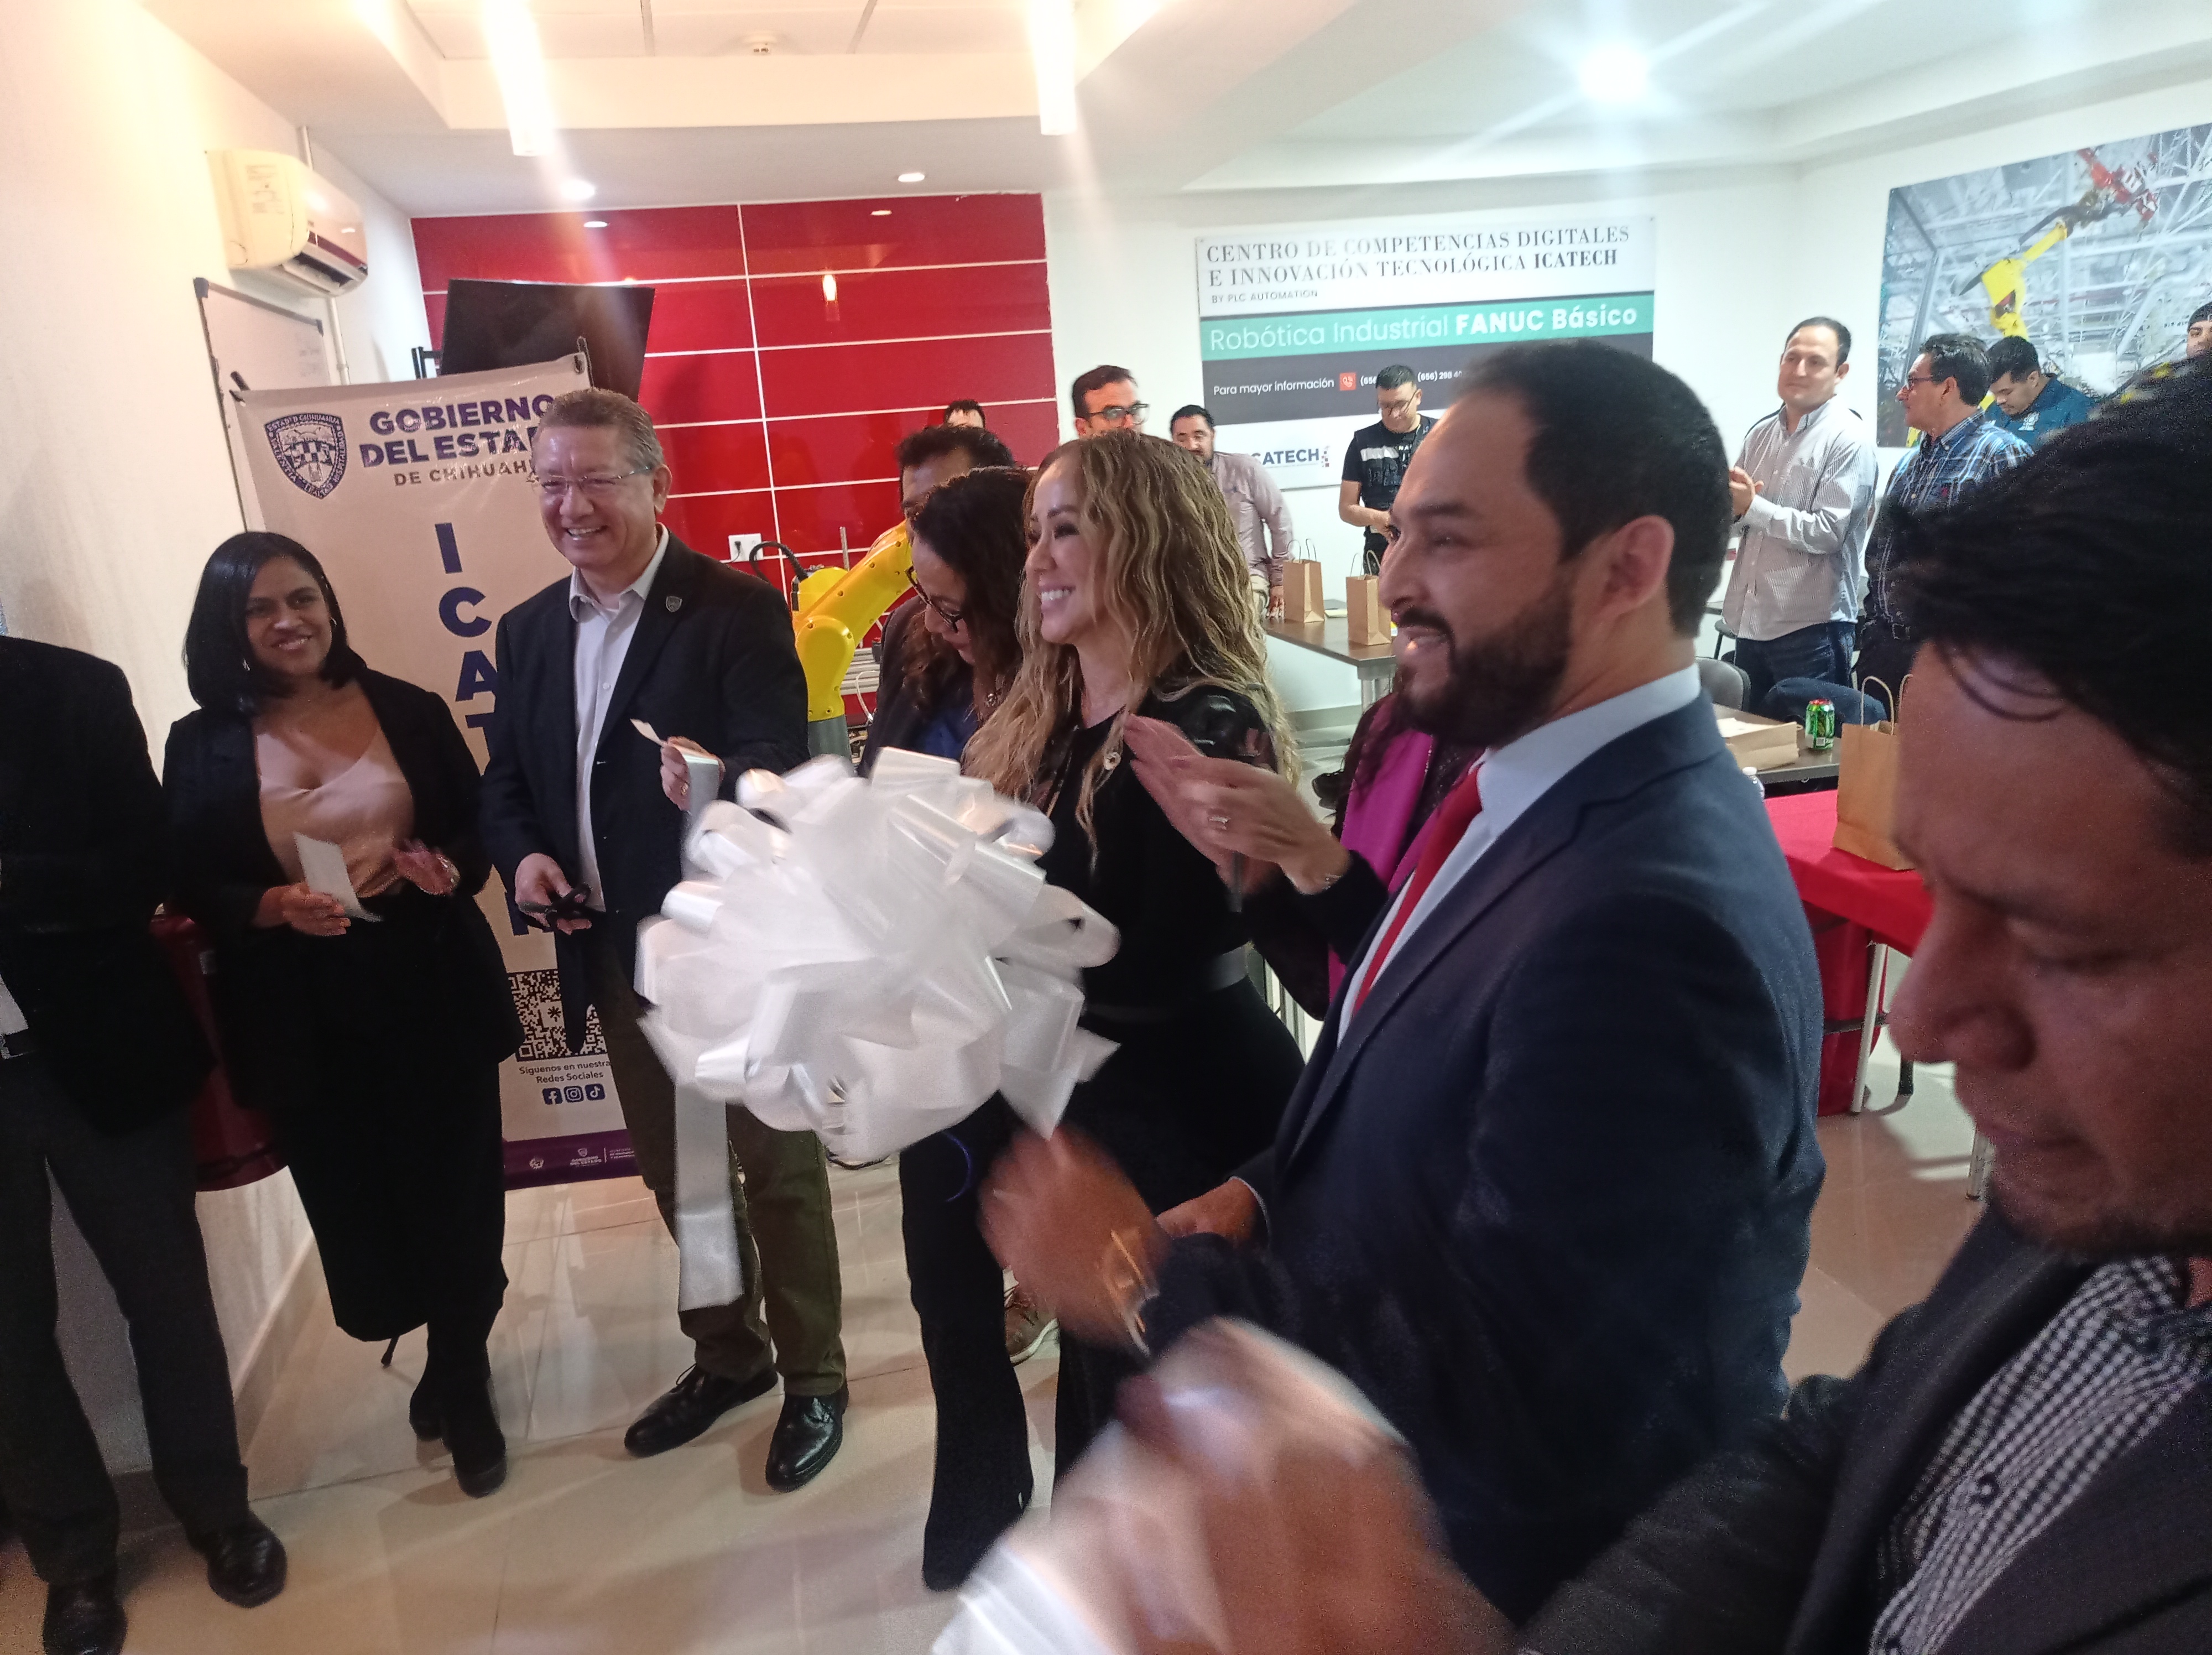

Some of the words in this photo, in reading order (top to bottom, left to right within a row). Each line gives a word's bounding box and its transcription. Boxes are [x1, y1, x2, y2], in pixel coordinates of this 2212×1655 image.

[1207, 242, 1298, 263] CENTRO
[1307, 240, 1337, 258] DE
[1344, 231, 1510, 255] COMPETENCIAS
[1518, 226, 1629, 248] DIGITALES
[1209, 269, 1222, 287] E
[1230, 259, 1369, 285] INNOVACIÓN
[1377, 252, 1526, 277] TECNOLÓGICA
[1534, 249, 1618, 269] ICATECH
[1212, 295, 1223, 304] BY
[1228, 293, 1246, 303] PLC
[1250, 289, 1318, 301] AUTOMATION
[1210, 324, 1325, 351] Robótica
[1333, 315, 1449, 344] Industrial
[1455, 310, 1545, 336] FANUC
[1552, 304, 1637, 330] Básico
[1213, 386, 1237, 395] Para
[1239, 384, 1272, 395] mayor
[1274, 377, 1334, 392] información
[369, 394, 554, 436] GOBIERNO
[359, 439, 430, 468] DEL
[393, 471, 421, 486] DE
[429, 459, 532, 483] CHIHUAH
[519, 1065, 562, 1076] Síguenos
[536, 1075, 565, 1084] Redes
[566, 1071, 604, 1081] Sociales
